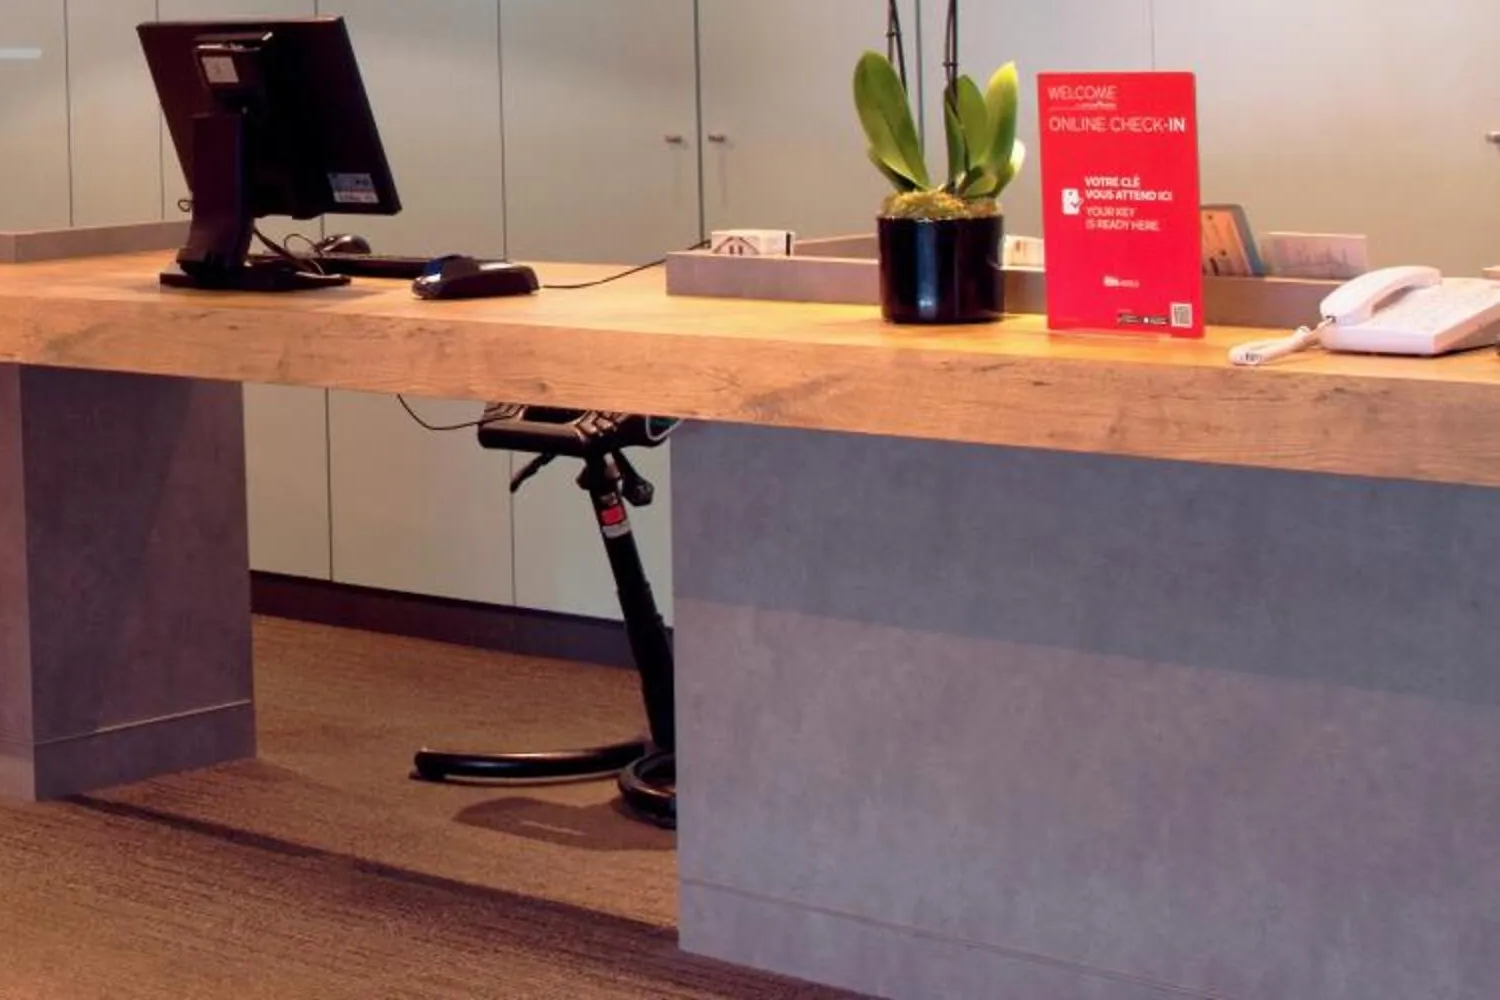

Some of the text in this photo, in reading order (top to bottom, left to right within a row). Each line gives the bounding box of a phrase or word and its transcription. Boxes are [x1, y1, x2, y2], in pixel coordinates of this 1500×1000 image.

[1047, 85, 1118, 102] WELCOME
[1049, 116, 1186, 133] ONLINE CHECK-IN
[1084, 176, 1119, 188] VOTRE
[1085, 189, 1115, 201] VOUS
[1115, 189, 1157, 201] ATTEND
[1086, 206, 1115, 218] YOUR
